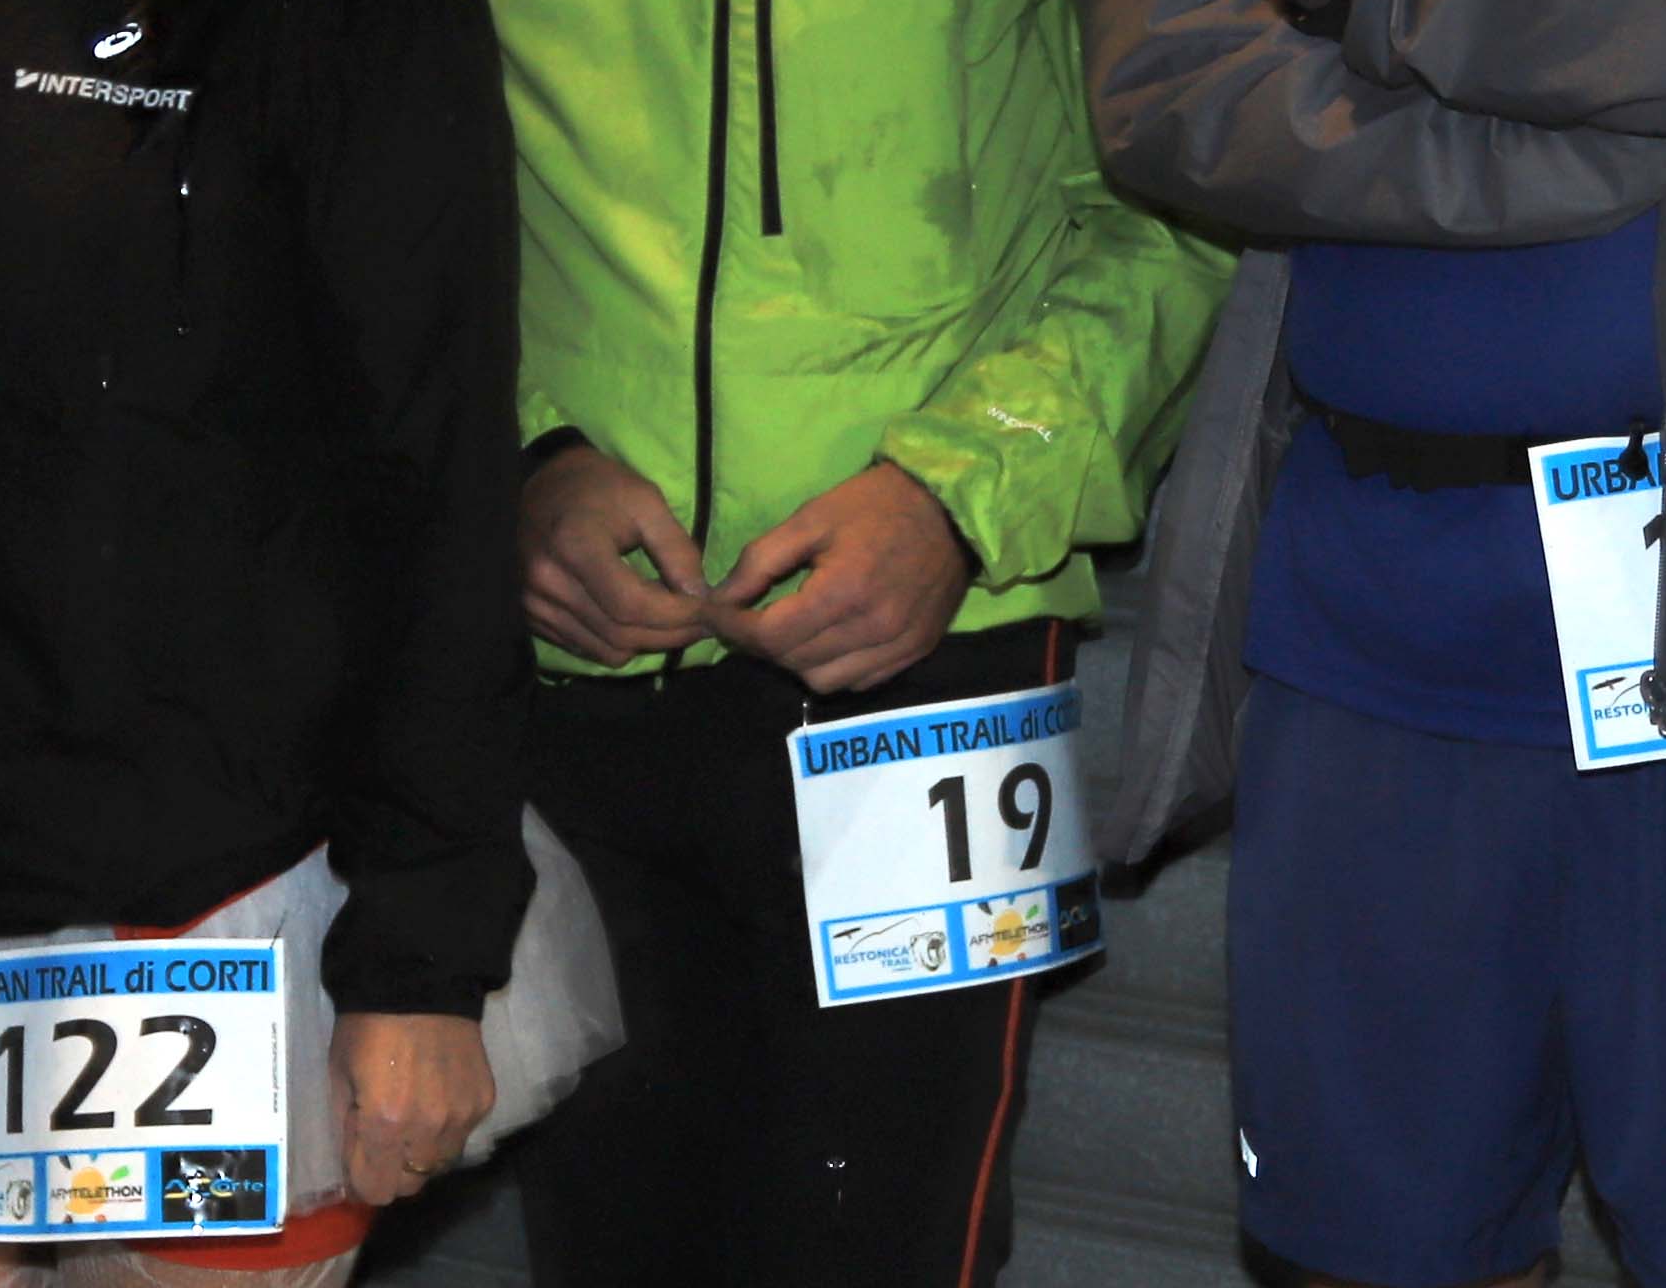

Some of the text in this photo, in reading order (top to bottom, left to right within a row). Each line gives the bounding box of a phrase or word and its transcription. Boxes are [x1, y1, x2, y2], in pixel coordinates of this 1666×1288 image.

[37, 71, 192, 112] INTERSPORT
[804, 728, 921, 775] URBAN
[929, 716, 1013, 753] TRAIL
[1020, 709, 1039, 741] di
[928, 762, 1052, 883] 19
[36, 964, 116, 998] TRAIL
[124, 961, 154, 993] di
[165, 959, 268, 993] CORTI
